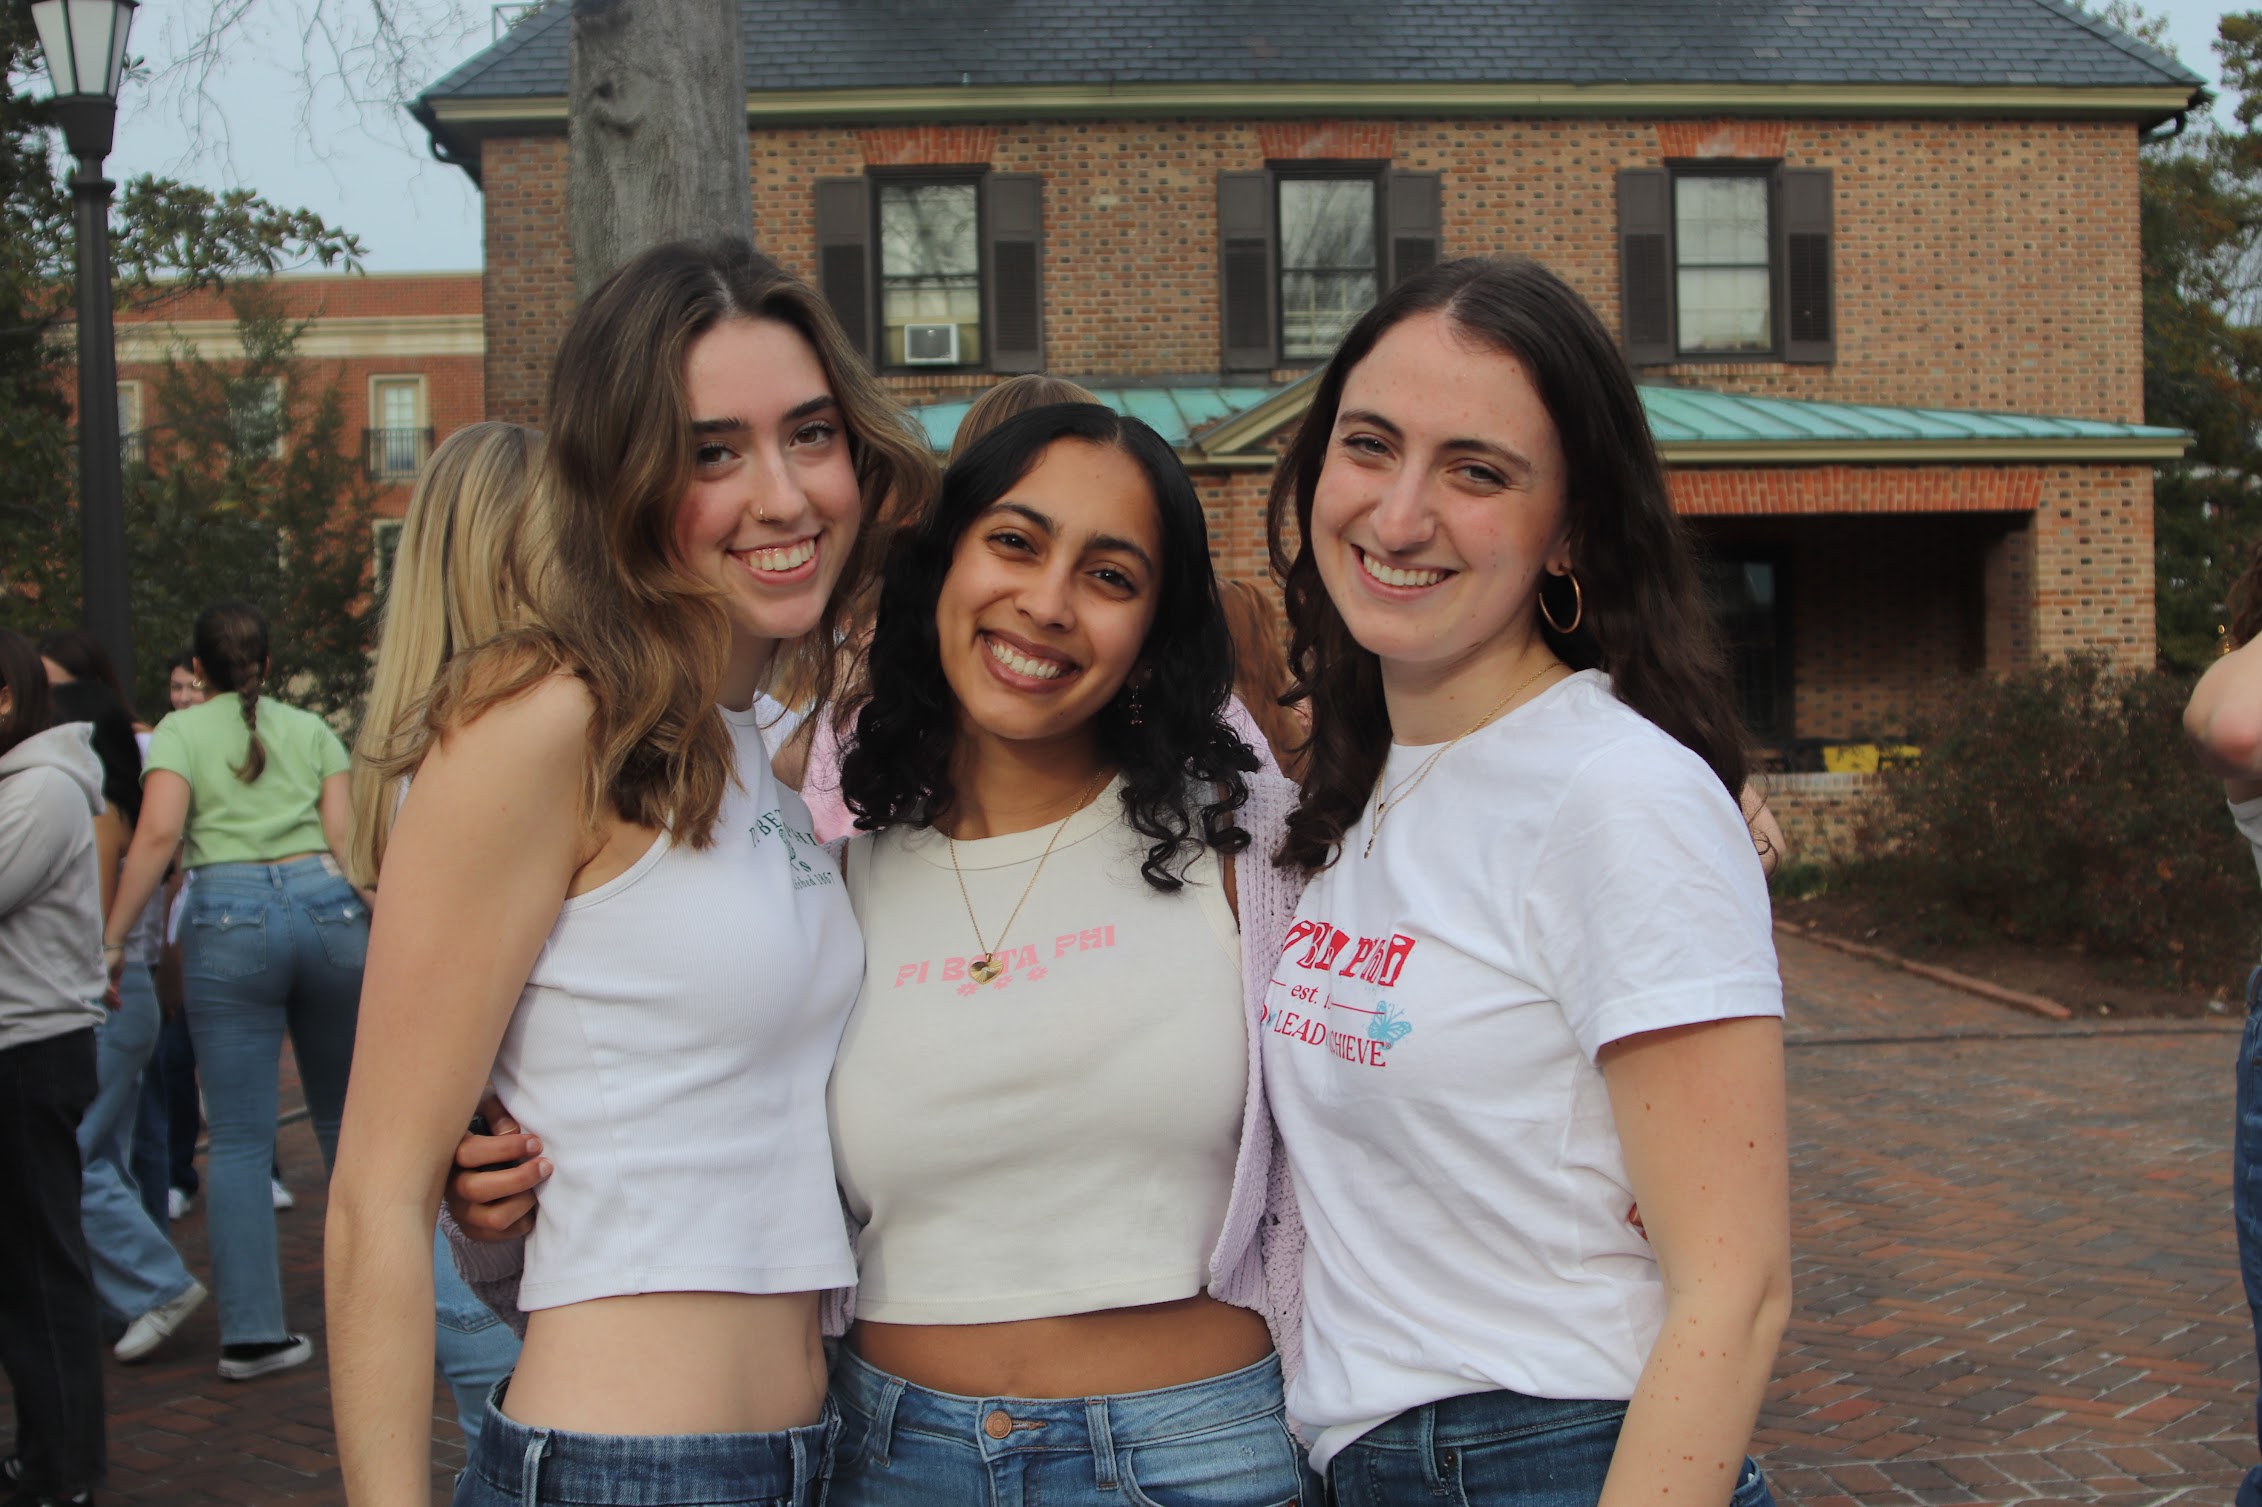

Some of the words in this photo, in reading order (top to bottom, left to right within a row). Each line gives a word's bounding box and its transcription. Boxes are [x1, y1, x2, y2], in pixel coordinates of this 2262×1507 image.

[894, 960, 930, 988] PI
[1055, 924, 1116, 959] PHI
[1291, 984, 1318, 1004] est.
[1273, 1009, 1327, 1046] LEAD
[1329, 1030, 1386, 1067] CHIEVE
